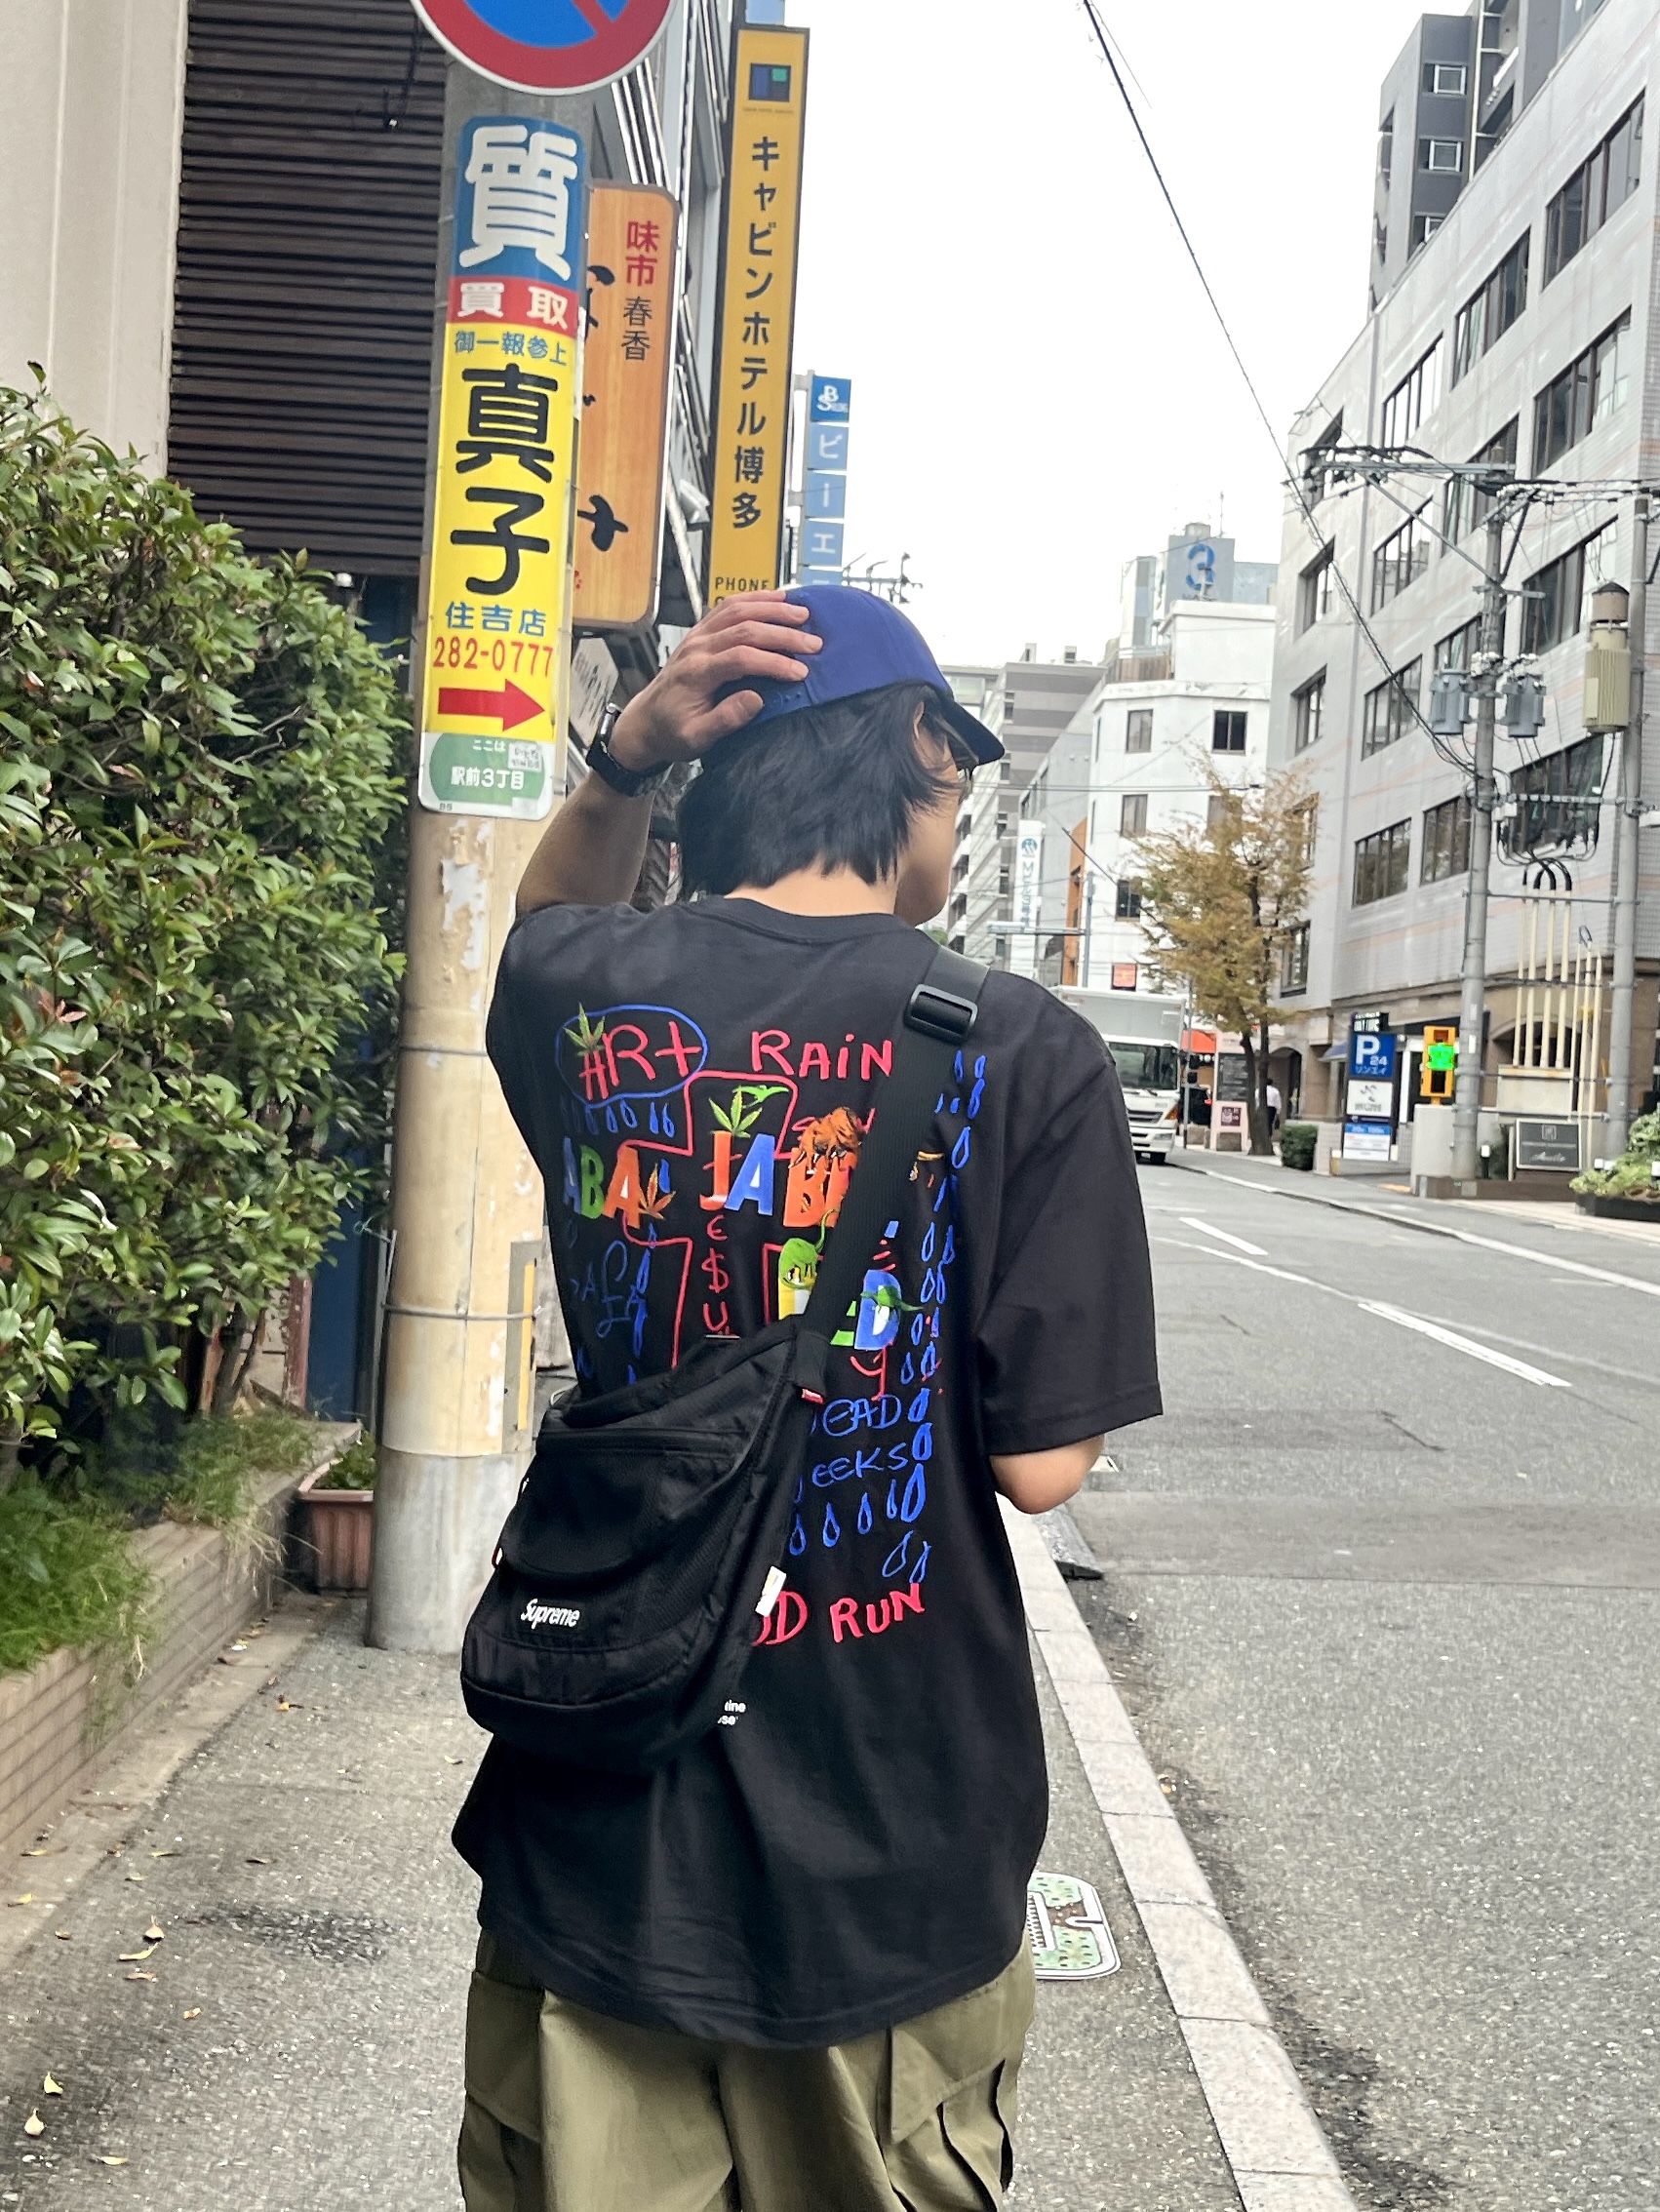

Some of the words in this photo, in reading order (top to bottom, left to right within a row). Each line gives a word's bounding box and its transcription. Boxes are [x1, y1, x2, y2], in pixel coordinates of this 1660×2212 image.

[458, 124, 578, 282] 質
[456, 281, 569, 331] 買取
[455, 330, 567, 366] 御一報参上
[731, 136, 781, 530] キャビンホテル博多
[450, 362, 559, 597] 真子
[810, 434, 844, 585] ビーエ
[445, 600, 547, 637] 住吉店
[432, 636, 554, 678] 282-0777
[451, 766, 524, 791] 駅前3丁目
[1356, 1034, 1380, 1065] P
[520, 1598, 580, 1630] Supreme
[830, 1582, 926, 1644] RUN
